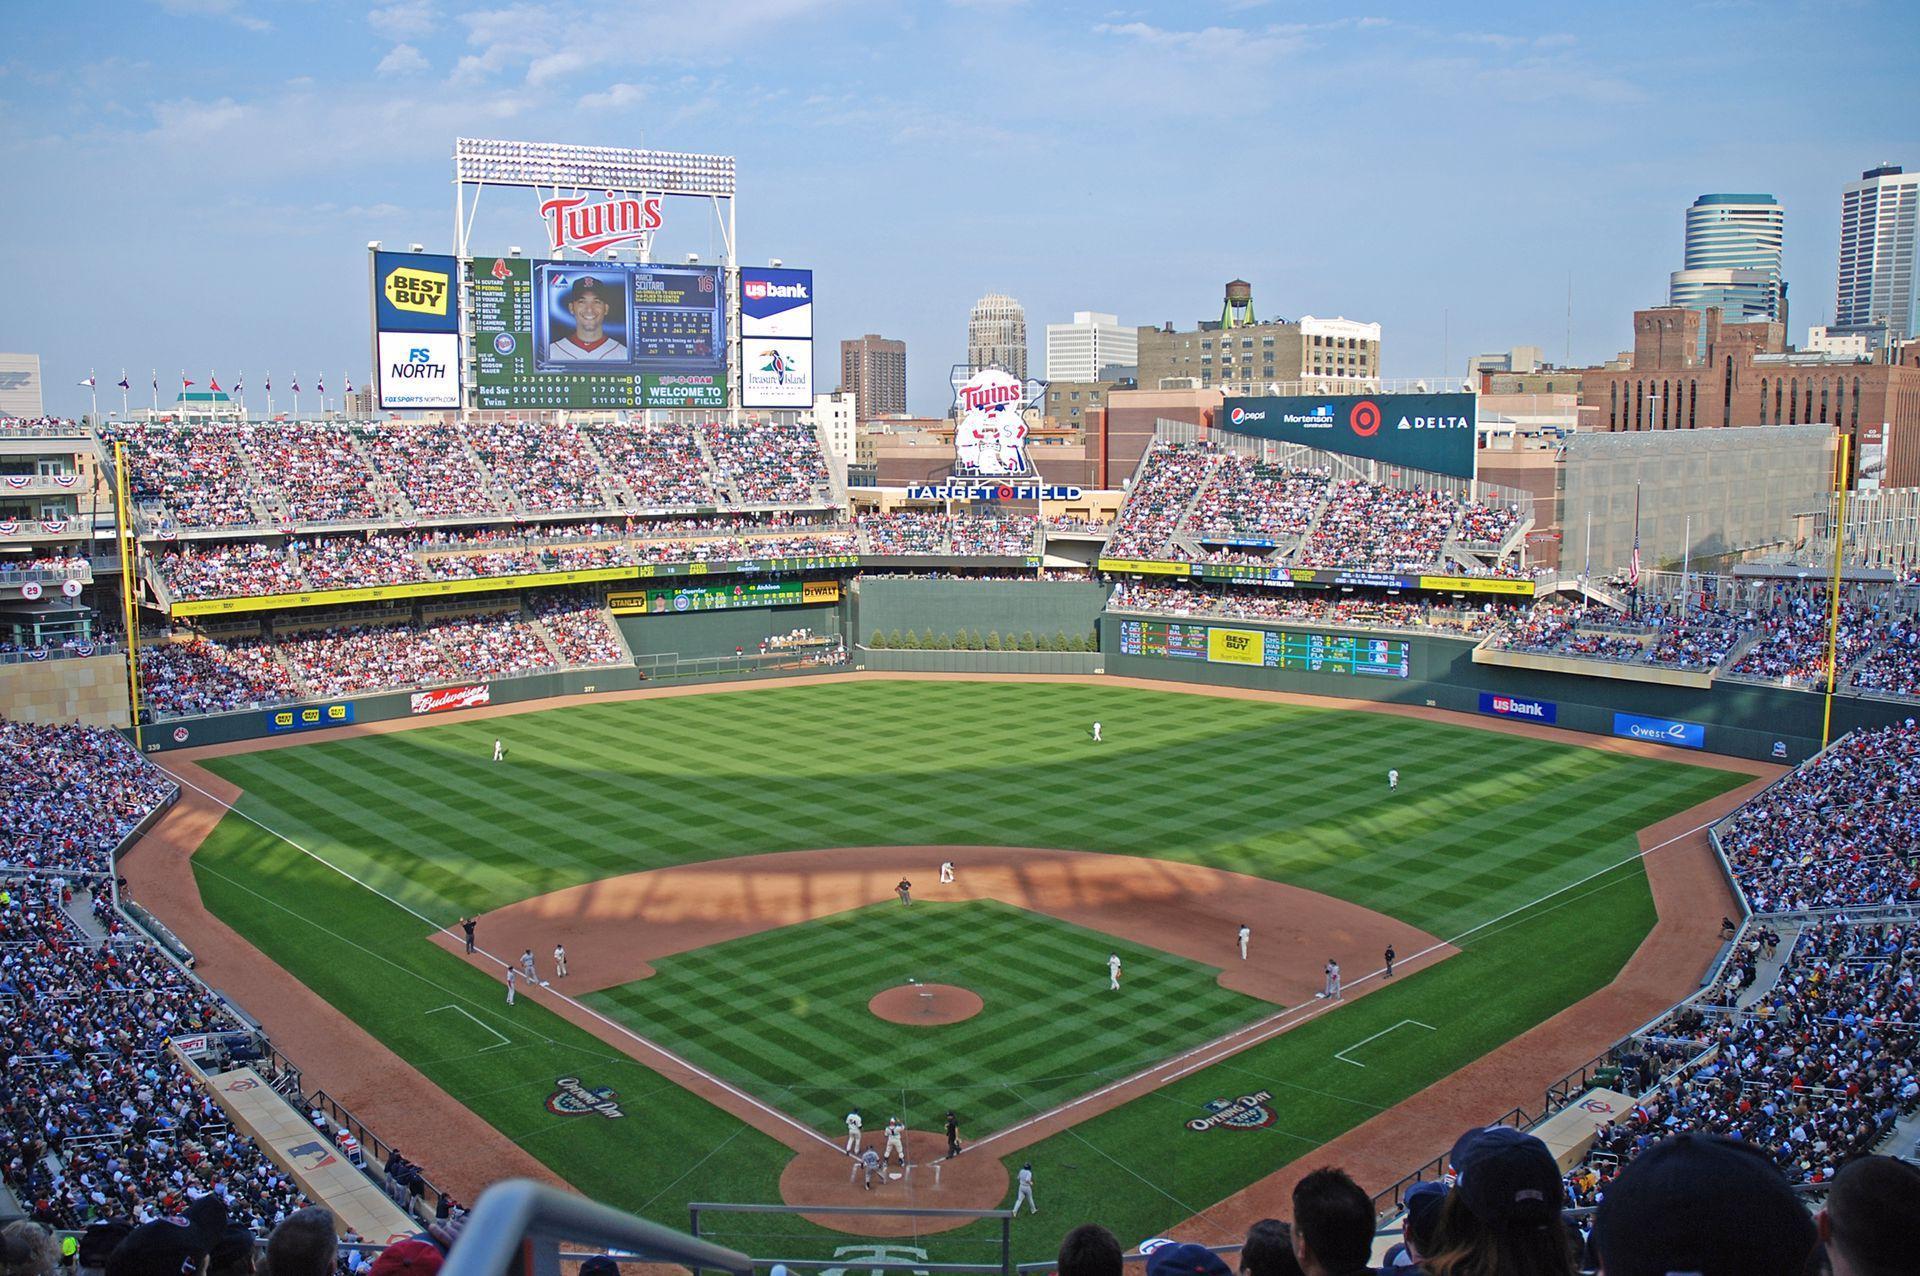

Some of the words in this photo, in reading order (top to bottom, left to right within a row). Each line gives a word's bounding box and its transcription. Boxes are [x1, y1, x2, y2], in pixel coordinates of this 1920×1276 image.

[540, 190, 664, 250] Twins
[394, 275, 446, 294] BEST
[635, 282, 664, 290] SCUTARO
[698, 276, 714, 292] 16
[395, 290, 441, 307] BUY
[409, 348, 430, 363] FS
[392, 364, 445, 378] NORTH
[634, 375, 641, 384] 0
[749, 374, 777, 384] Treasure
[785, 373, 806, 384] Island
[480, 386, 494, 394] Red
[496, 386, 510, 394] Sox
[634, 386, 641, 394] 0
[650, 387, 704, 397] WELCOME
[706, 387, 721, 397] TO
[483, 398, 506, 406] Twins
[634, 396, 641, 406] 0
[960, 382, 1020, 412] Twins
[1245, 411, 1265, 422] pepsi
[1284, 414, 1333, 423] Mortenson
[1415, 416, 1468, 429] DELTA
[907, 486, 995, 500] TARGET
[1018, 486, 1082, 500] FIELD
[611, 598, 642, 606] STANLEY
[1226, 635, 1250, 644] BEST
[1226, 642, 1247, 651] BUY
[419, 685, 488, 712] Budweiser
[1631, 724, 1665, 738] Qwest
[558, 1078, 600, 1105] OPENING
[594, 1102, 624, 1118] DAY
[1187, 1104, 1245, 1130] OPENING
[1237, 1090, 1271, 1107] DAY
